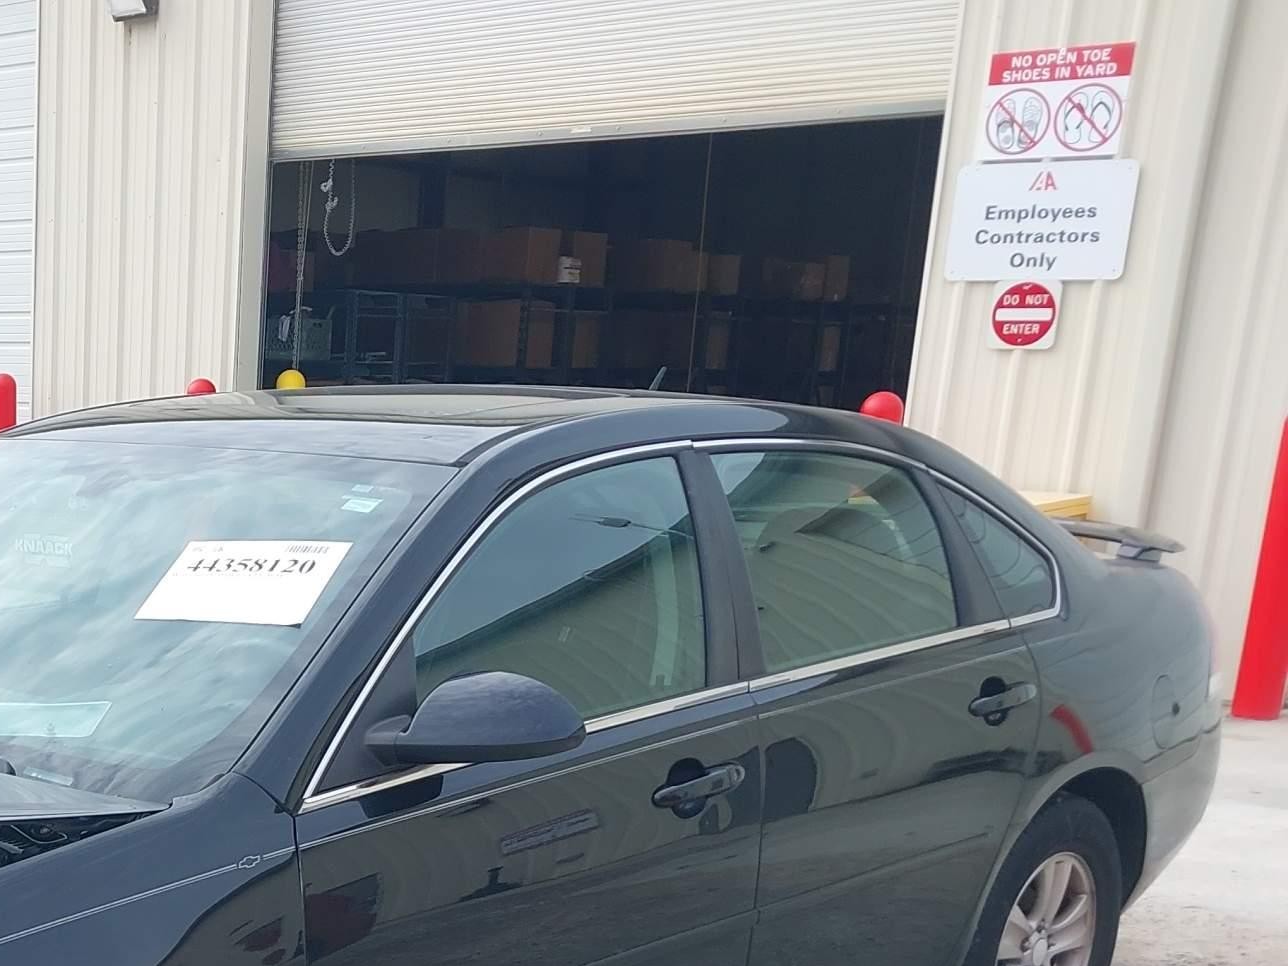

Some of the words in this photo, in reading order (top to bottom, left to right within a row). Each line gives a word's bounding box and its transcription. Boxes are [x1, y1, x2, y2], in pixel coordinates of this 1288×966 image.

[1011, 55, 1032, 68] NO
[1036, 51, 1076, 64] OPEN
[1082, 48, 1111, 62] TOE
[1002, 68, 1050, 82] SHOES
[1055, 66, 1070, 78] IN
[1075, 63, 1118, 77] YARD
[984, 205, 1098, 225] Employees
[974, 229, 1100, 245] Contractors
[1009, 252, 1057, 271] Only
[1003, 295, 1020, 305] DO
[1025, 294, 1049, 305] NOT
[1002, 323, 1040, 335] ENTER
[186, 558, 317, 575] 44358120
